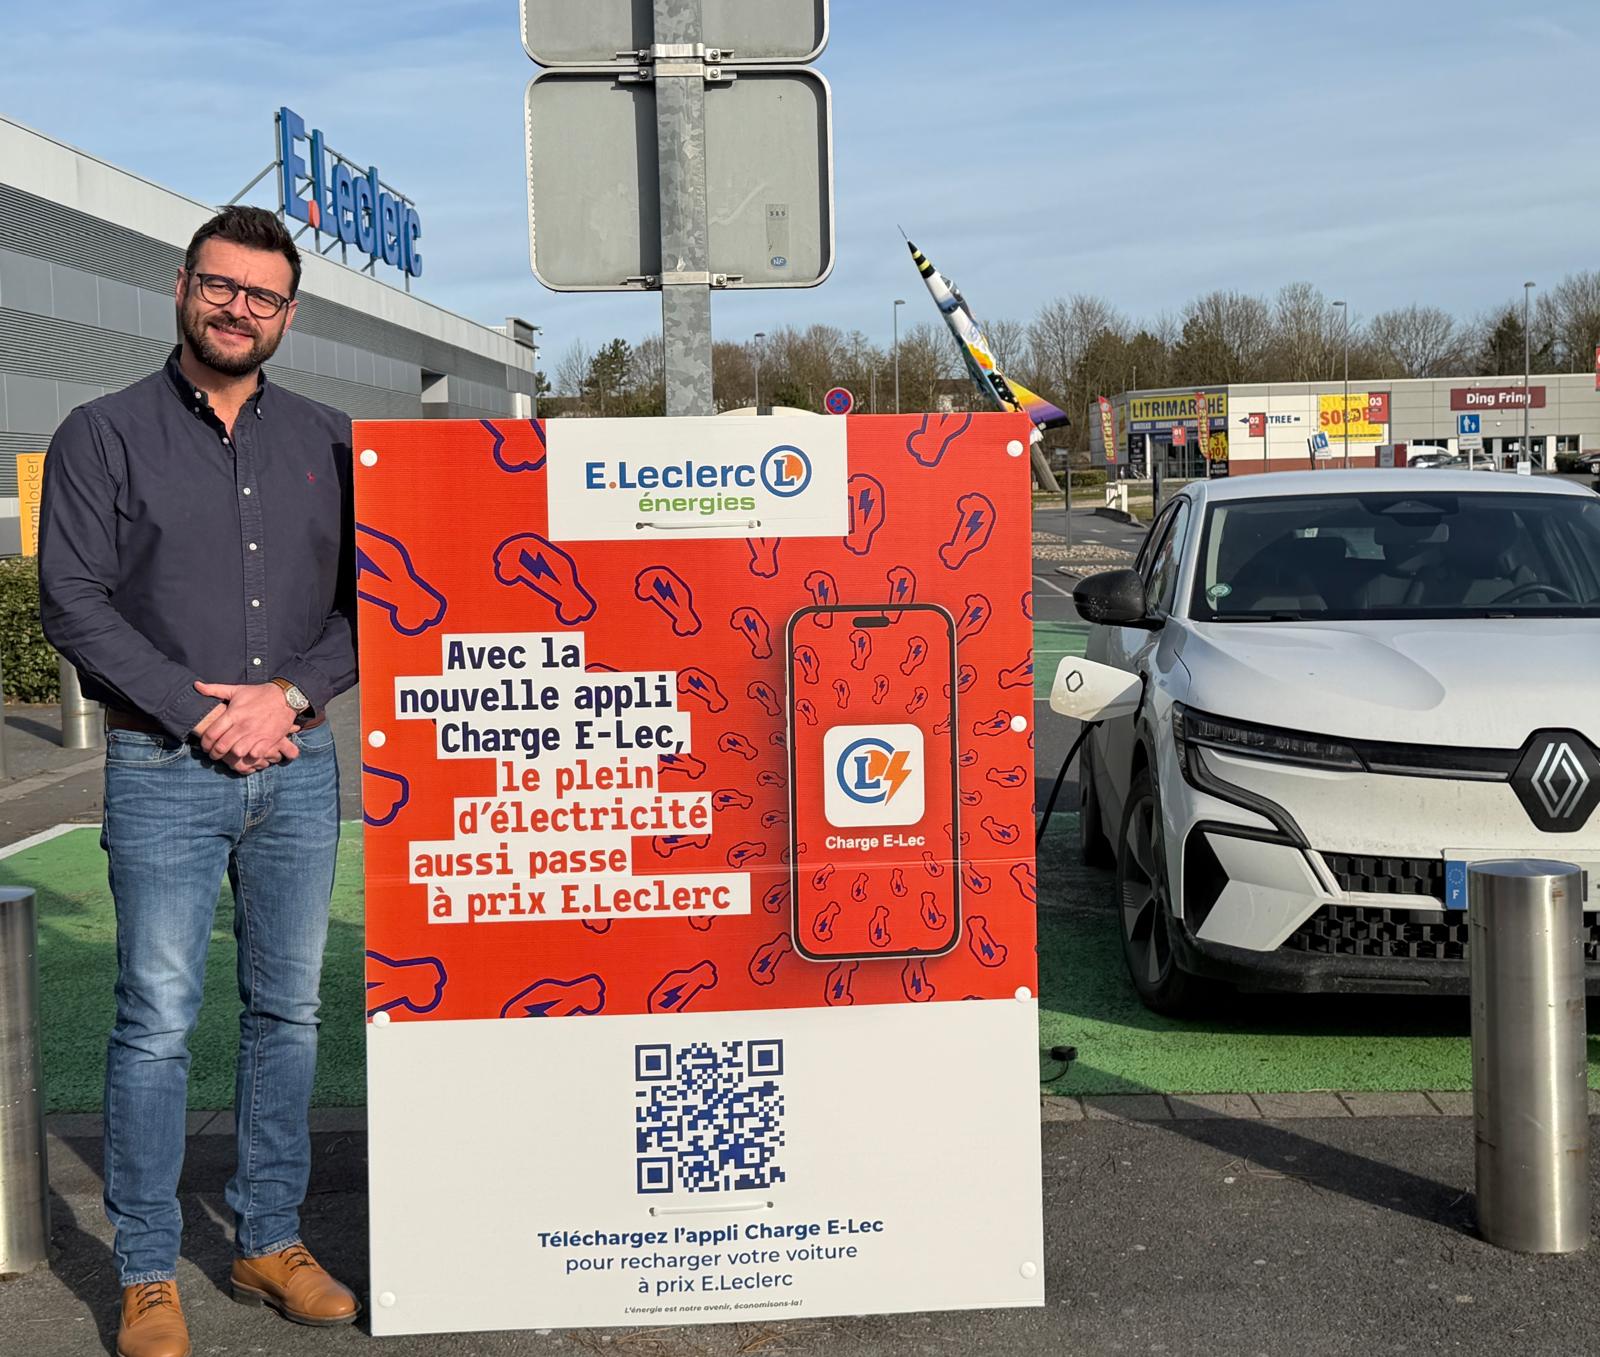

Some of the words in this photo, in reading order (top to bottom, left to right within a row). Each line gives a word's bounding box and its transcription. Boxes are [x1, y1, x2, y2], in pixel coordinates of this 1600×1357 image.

[280, 106, 422, 278] E.Leclerc
[1132, 396, 1225, 418] LITRIMARHÉ
[1369, 397, 1383, 406] 03
[1466, 393, 1495, 406] Ding
[1498, 392, 1531, 405] Fring
[1173, 428, 1182, 436] 01
[1249, 416, 1260, 424] 02
[1265, 415, 1292, 424] TREE
[585, 460, 756, 489] E.Leclerc
[638, 492, 756, 516] énergies
[447, 640, 527, 670] Avec
[541, 637, 581, 669] la
[400, 678, 560, 713] nouvelle
[574, 674, 673, 717] appli
[441, 722, 561, 760] Charge
[575, 720, 685, 754] E-Lec,
[501, 760, 541, 792] le
[555, 756, 655, 799] plein
[458, 796, 708, 835] d'électricité
[825, 835, 879, 851] Charge
[883, 834, 926, 847] E-Lec
[414, 841, 514, 878] aussi
[529, 848, 628, 880] passe
[432, 886, 453, 918] à
[467, 882, 547, 921] prix
[560, 879, 731, 914] E.Leclerc
[1452, 889, 1460, 899] F
[537, 1229, 668, 1249] Téléchargez
[674, 1223, 739, 1247] l'appli
[744, 1222, 821, 1241] Charge
[827, 1218, 884, 1235] E-Lec
[566, 1257, 614, 1275] pour
[620, 1252, 721, 1271] recharger
[727, 1249, 780, 1265] votre
[786, 1243, 858, 1262] voiture
[638, 1277, 650, 1294] à
[656, 1275, 695, 1297] prix
[702, 1271, 793, 1292] E.Leclerc
[624, 1306, 663, 1315] L'énergie
[703, 1303, 733, 1312] avenir,
